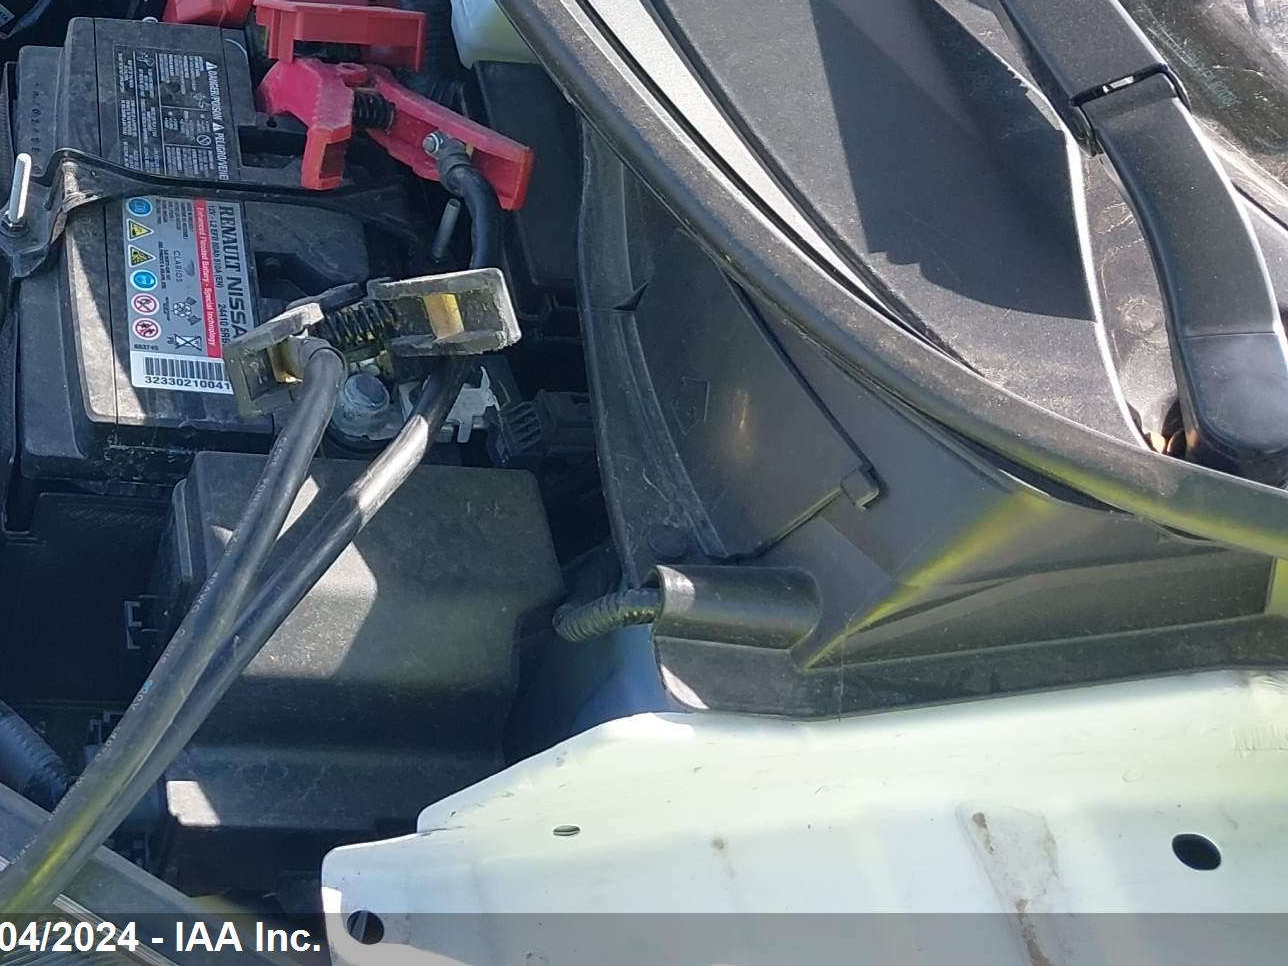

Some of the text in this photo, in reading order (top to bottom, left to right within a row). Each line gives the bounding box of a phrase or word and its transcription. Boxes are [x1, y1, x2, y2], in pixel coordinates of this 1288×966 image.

[208, 70, 223, 121] DANGER/POISON
[196, 206, 208, 235] Enhanced
[208, 205, 218, 216] 12V
[199, 236, 210, 260] Flooded
[175, 250, 184, 283] CLARIOS
[200, 260, 212, 283] Battery
[219, 205, 248, 339] RENAULT NISSA
[202, 287, 215, 310] Special
[217, 303, 228, 326] 24410
[144, 375, 231, 390] 32330210041
